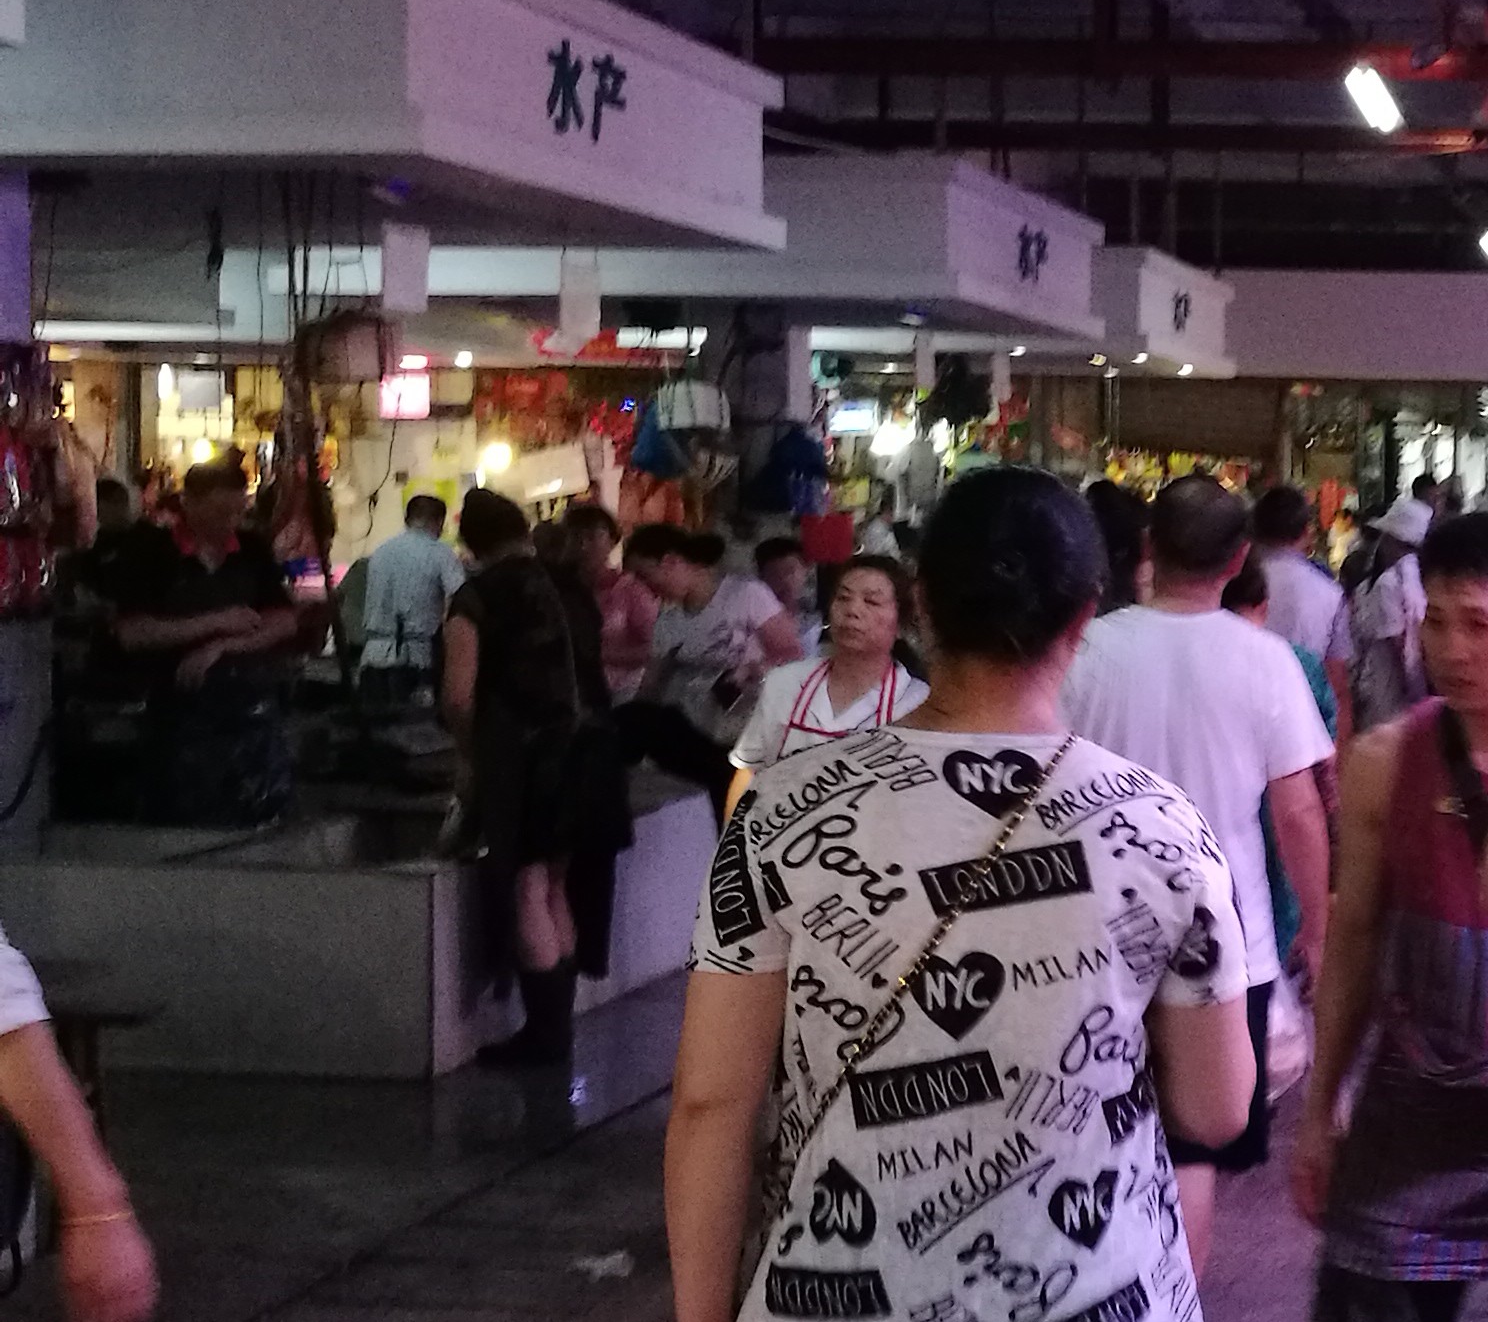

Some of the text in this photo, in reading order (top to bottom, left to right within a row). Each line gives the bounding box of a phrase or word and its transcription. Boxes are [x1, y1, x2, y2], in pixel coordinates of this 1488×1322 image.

[956, 760, 1029, 795] NYC
[782, 814, 907, 916] Paris
[924, 966, 991, 1012] NYC
[1012, 944, 1111, 991] MILAN
[877, 1128, 973, 1182] MILAN
[896, 1129, 1041, 1250] BARCELONA
[1063, 1186, 1115, 1236] NYC
